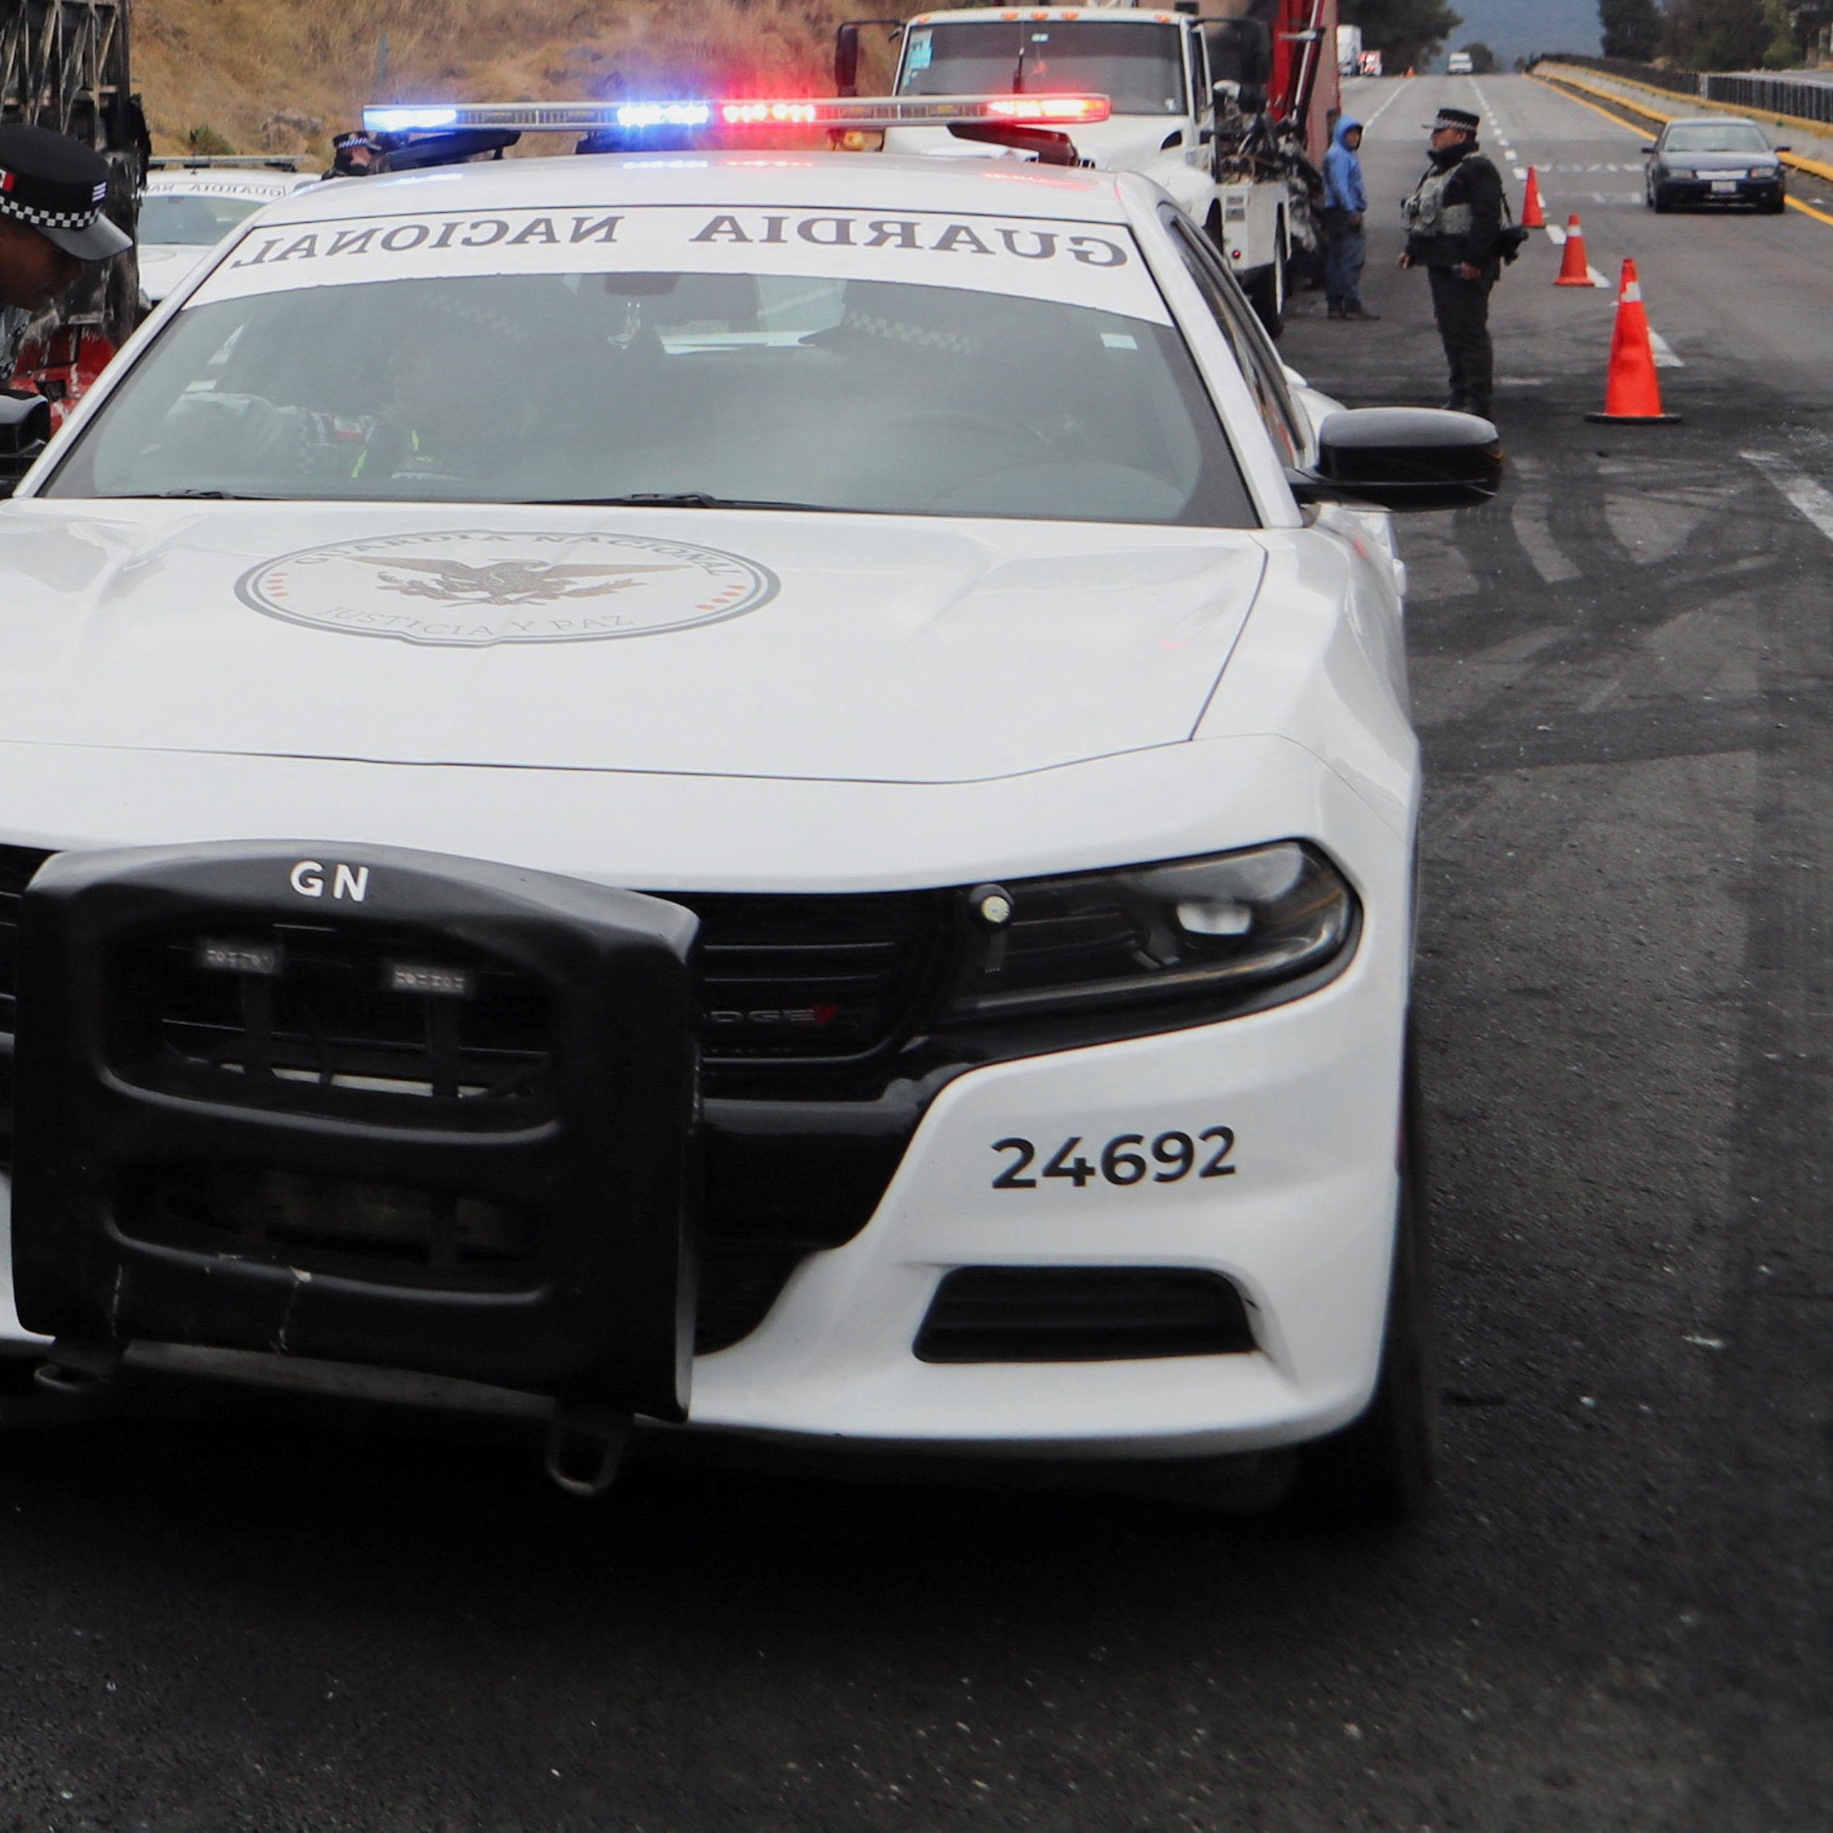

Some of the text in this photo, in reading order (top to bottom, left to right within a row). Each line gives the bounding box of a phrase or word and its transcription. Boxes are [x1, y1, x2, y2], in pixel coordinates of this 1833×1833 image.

[294, 534, 744, 576] GUARDIA NACIONAL
[315, 606, 633, 636] JUSTICIA Y PAZ
[290, 859, 369, 902] GN
[990, 1125, 1237, 1189] 24692
